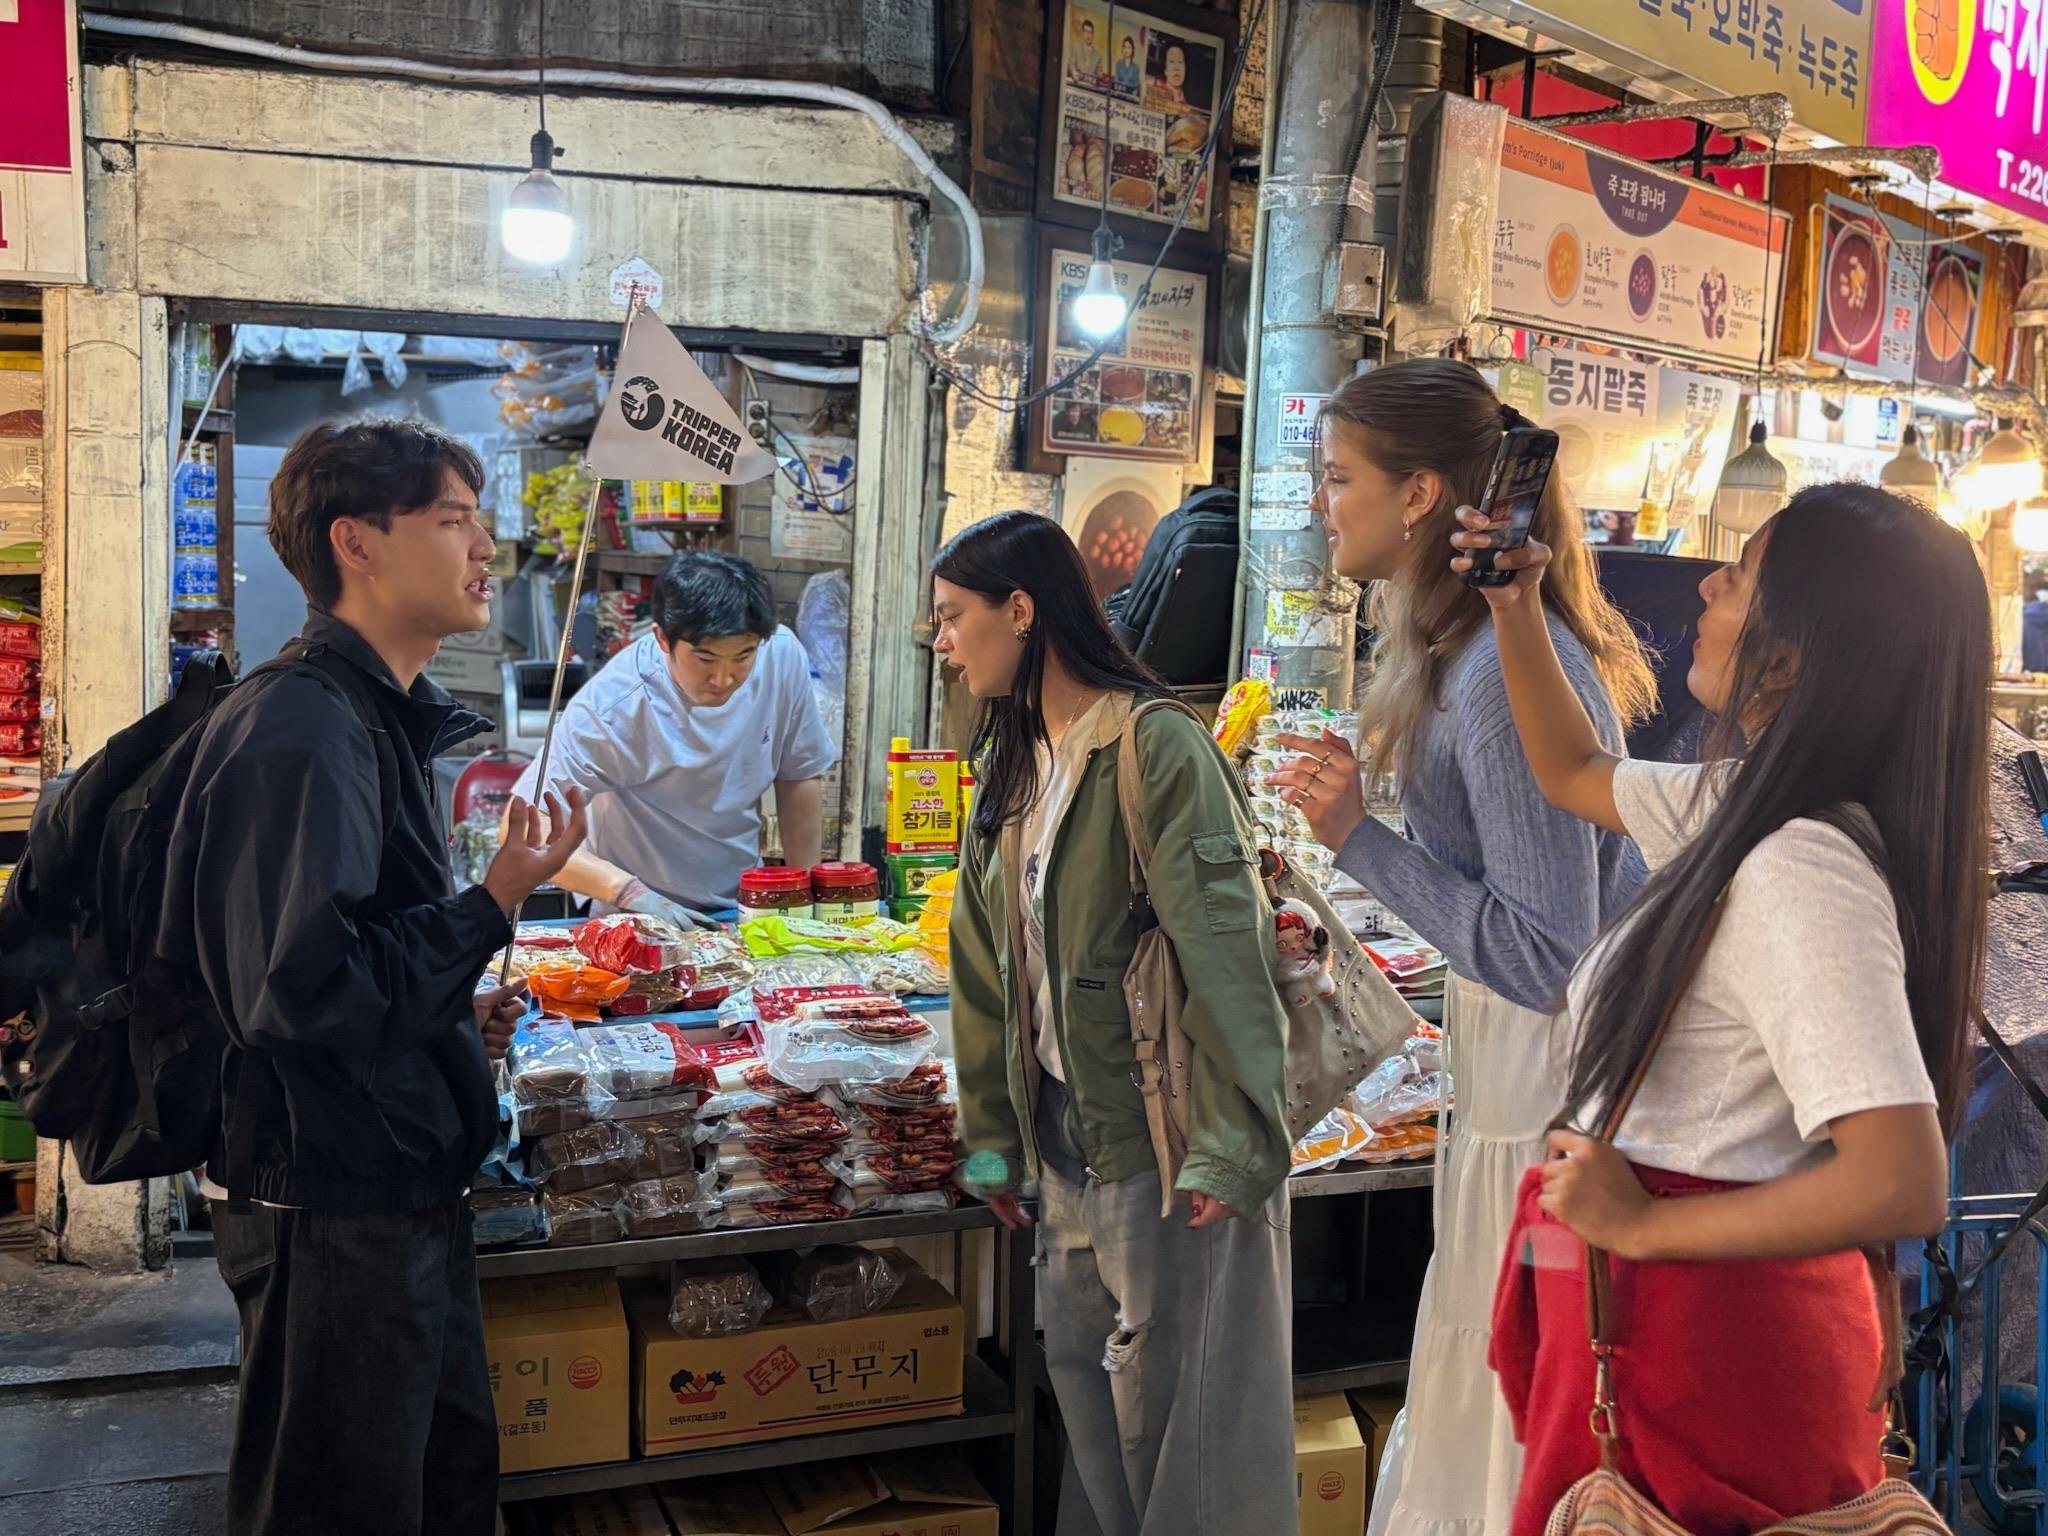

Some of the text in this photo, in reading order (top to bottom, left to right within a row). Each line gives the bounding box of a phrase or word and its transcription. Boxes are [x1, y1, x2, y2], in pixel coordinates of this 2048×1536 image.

[1065, 92, 1087, 109] KBS
[1519, 145, 1548, 167] Porridge
[1550, 157, 1565, 173] (juk)
[1607, 174, 1667, 213] 죽 포장 됩니다
[1621, 206, 1648, 223] TAKE OUT
[1060, 261, 1086, 279] KBS
[1586, 242, 1611, 276] 호박죽
[1661, 264, 1677, 292] 팥죽
[1548, 357, 1647, 417] 동지팥죽
[1686, 383, 1723, 412] 죽 포장
[672, 399, 742, 453] TRIPPER
[661, 418, 736, 475] KOREA
[910, 799, 944, 810] 고소한
[902, 811, 953, 830] 참기름
[923, 1325, 950, 1338] 업소용
[573, 1367, 597, 1375] HACCP
[806, 1348, 919, 1395] 단무지
[525, 1397, 548, 1417] 품
[669, 1411, 727, 1426] 단무지제조공장
